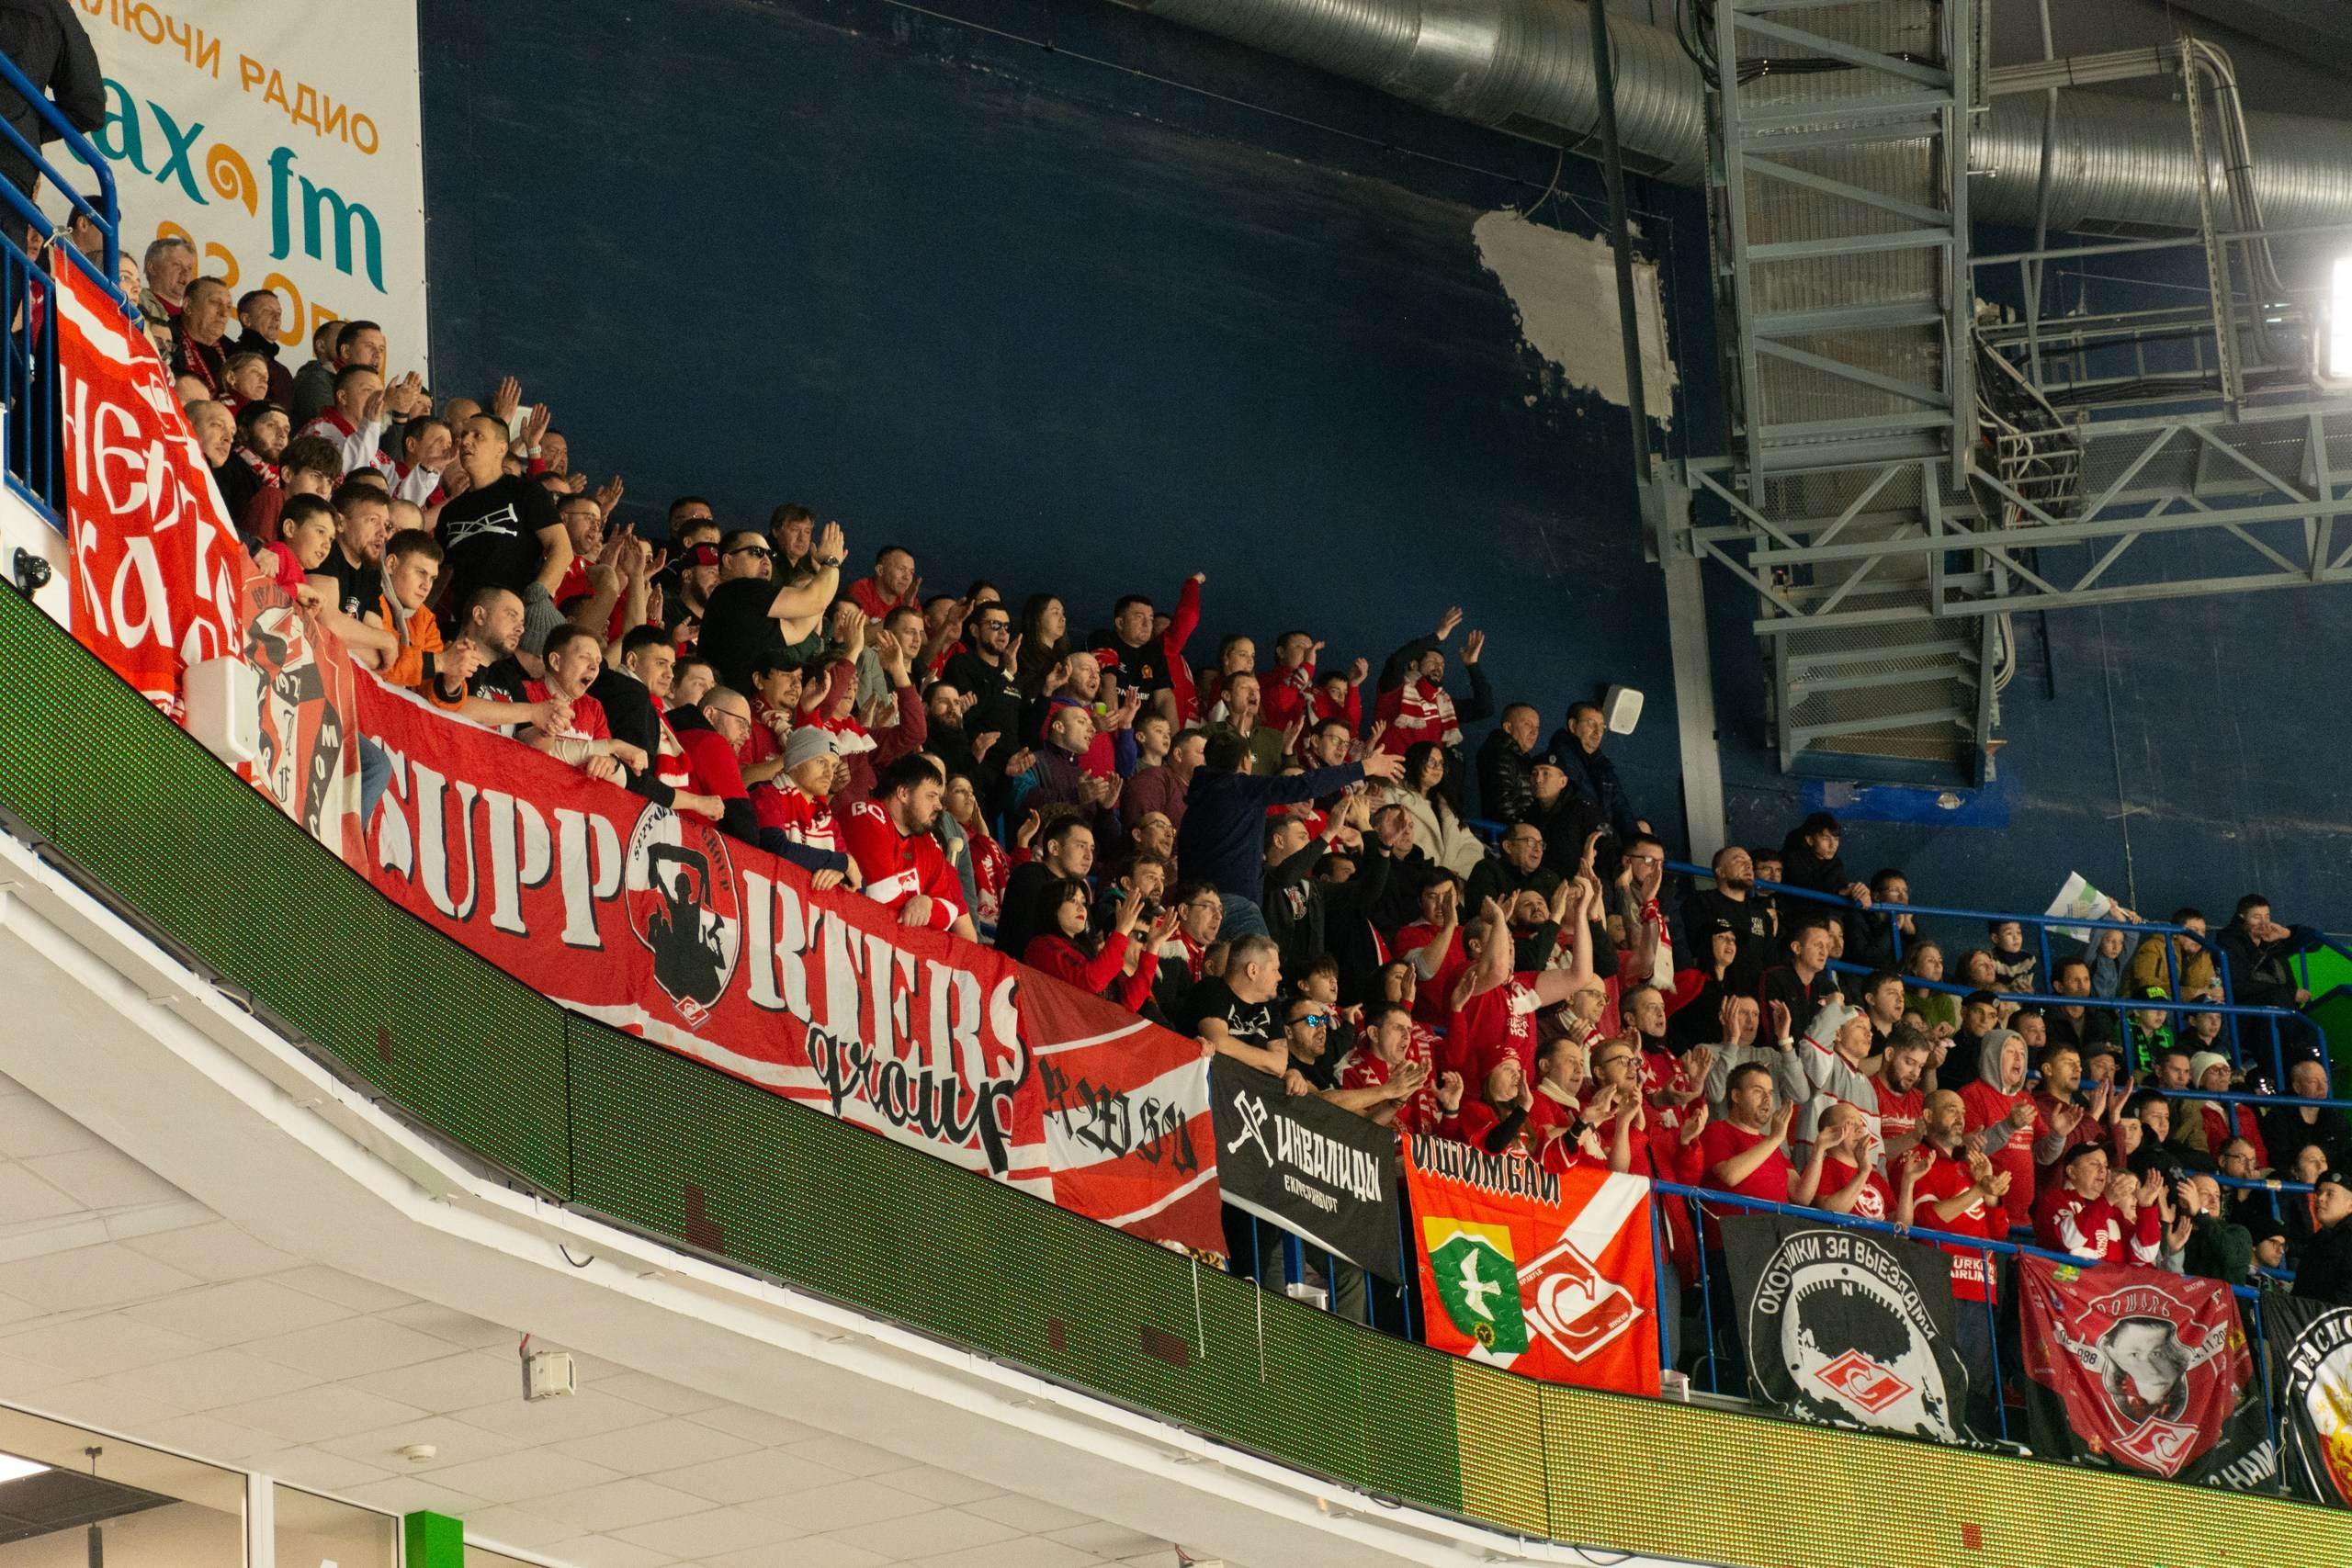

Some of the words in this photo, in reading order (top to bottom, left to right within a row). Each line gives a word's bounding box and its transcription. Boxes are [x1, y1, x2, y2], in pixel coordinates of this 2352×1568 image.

[65, 77, 210, 207] ax
[238, 53, 379, 155] РАДИО
[807, 1021, 1022, 1176] group
[1274, 1114, 1382, 1202] ИНВАЛИДЫ
[1518, 1268, 1544, 1287] SPARTAK
[1758, 1236, 1822, 1315] ОХОТИКИ
[1826, 1237, 1850, 1259] ЗА
[1607, 1312, 1630, 1330] MOSCOW
